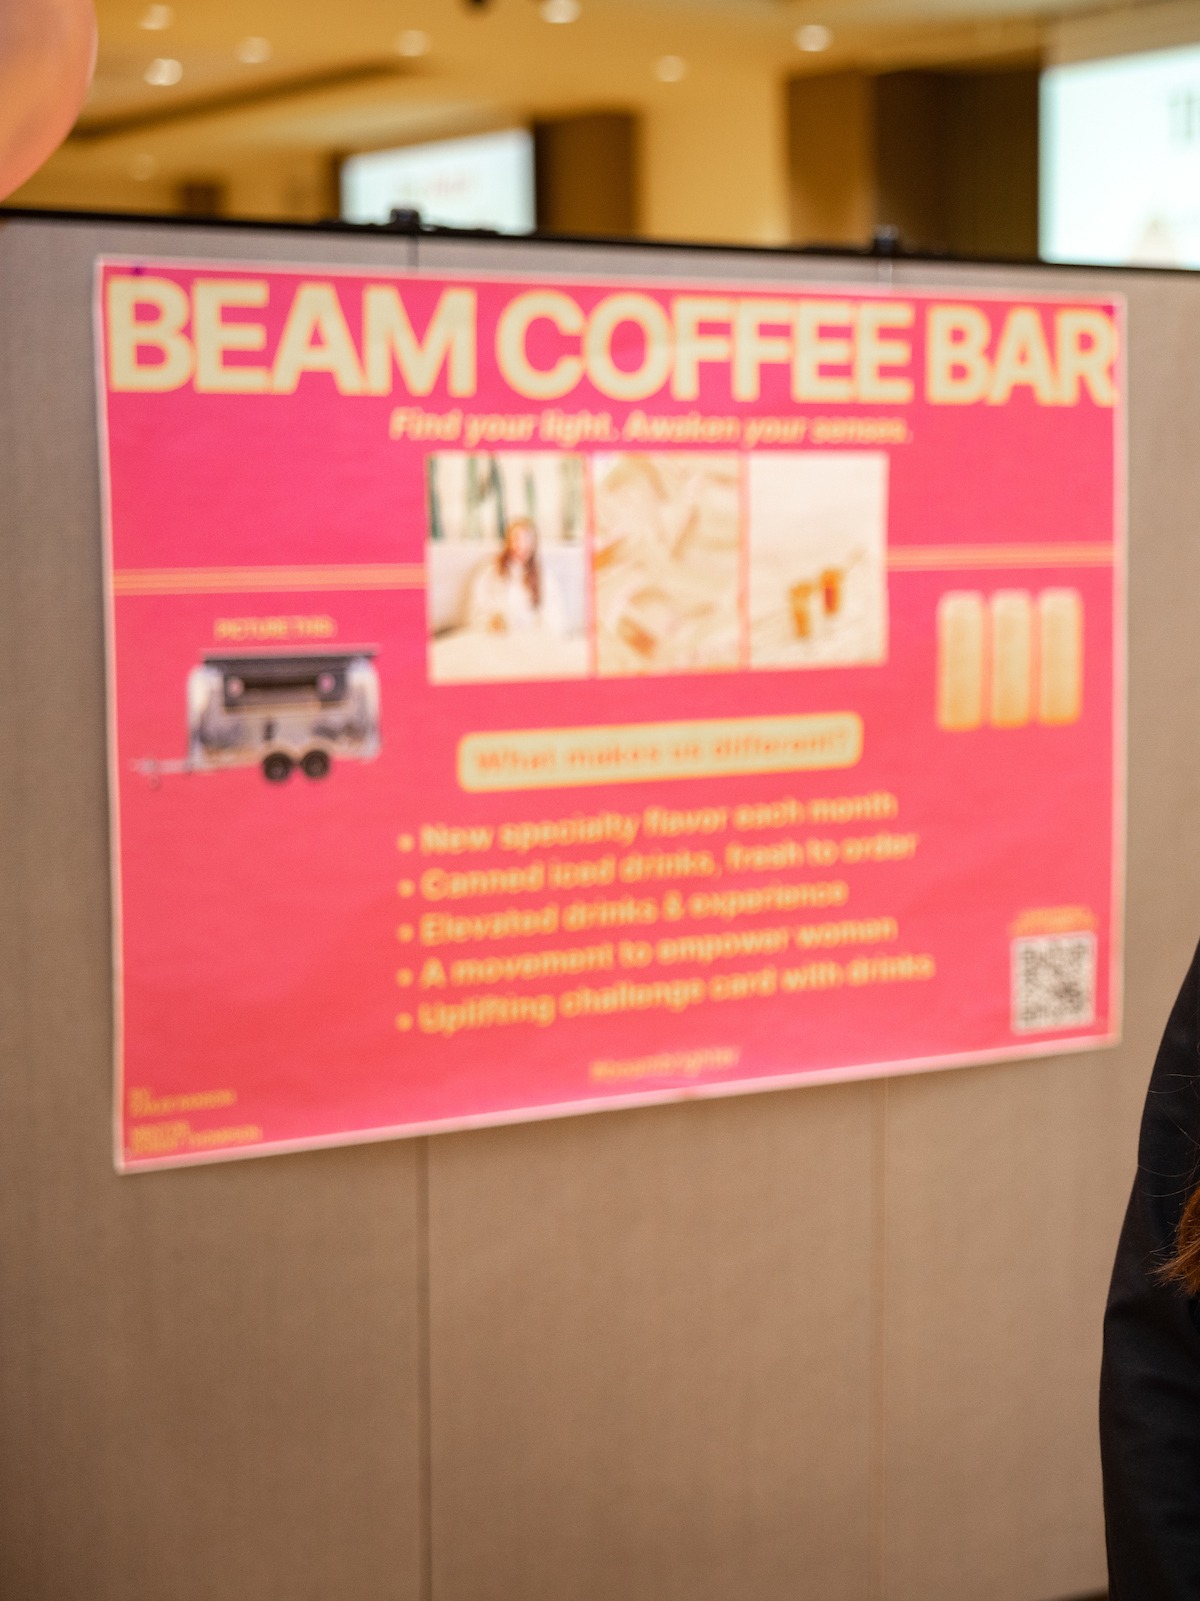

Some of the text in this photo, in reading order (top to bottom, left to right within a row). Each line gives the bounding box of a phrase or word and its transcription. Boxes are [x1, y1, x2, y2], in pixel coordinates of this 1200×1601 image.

[107, 276, 1119, 407] BEAM COFFEE BAR
[392, 408, 911, 451] Find your light. Awaken your senses.
[477, 724, 849, 773] What makes us different?
[421, 790, 894, 852] New specialty flavor each month
[421, 833, 914, 900] Canned iced drinks, fresh to order
[421, 882, 847, 945] Elevated drinks & experience
[421, 918, 894, 988] A movement to empower women
[418, 955, 934, 1035] Uplifting challenge card with drinks
